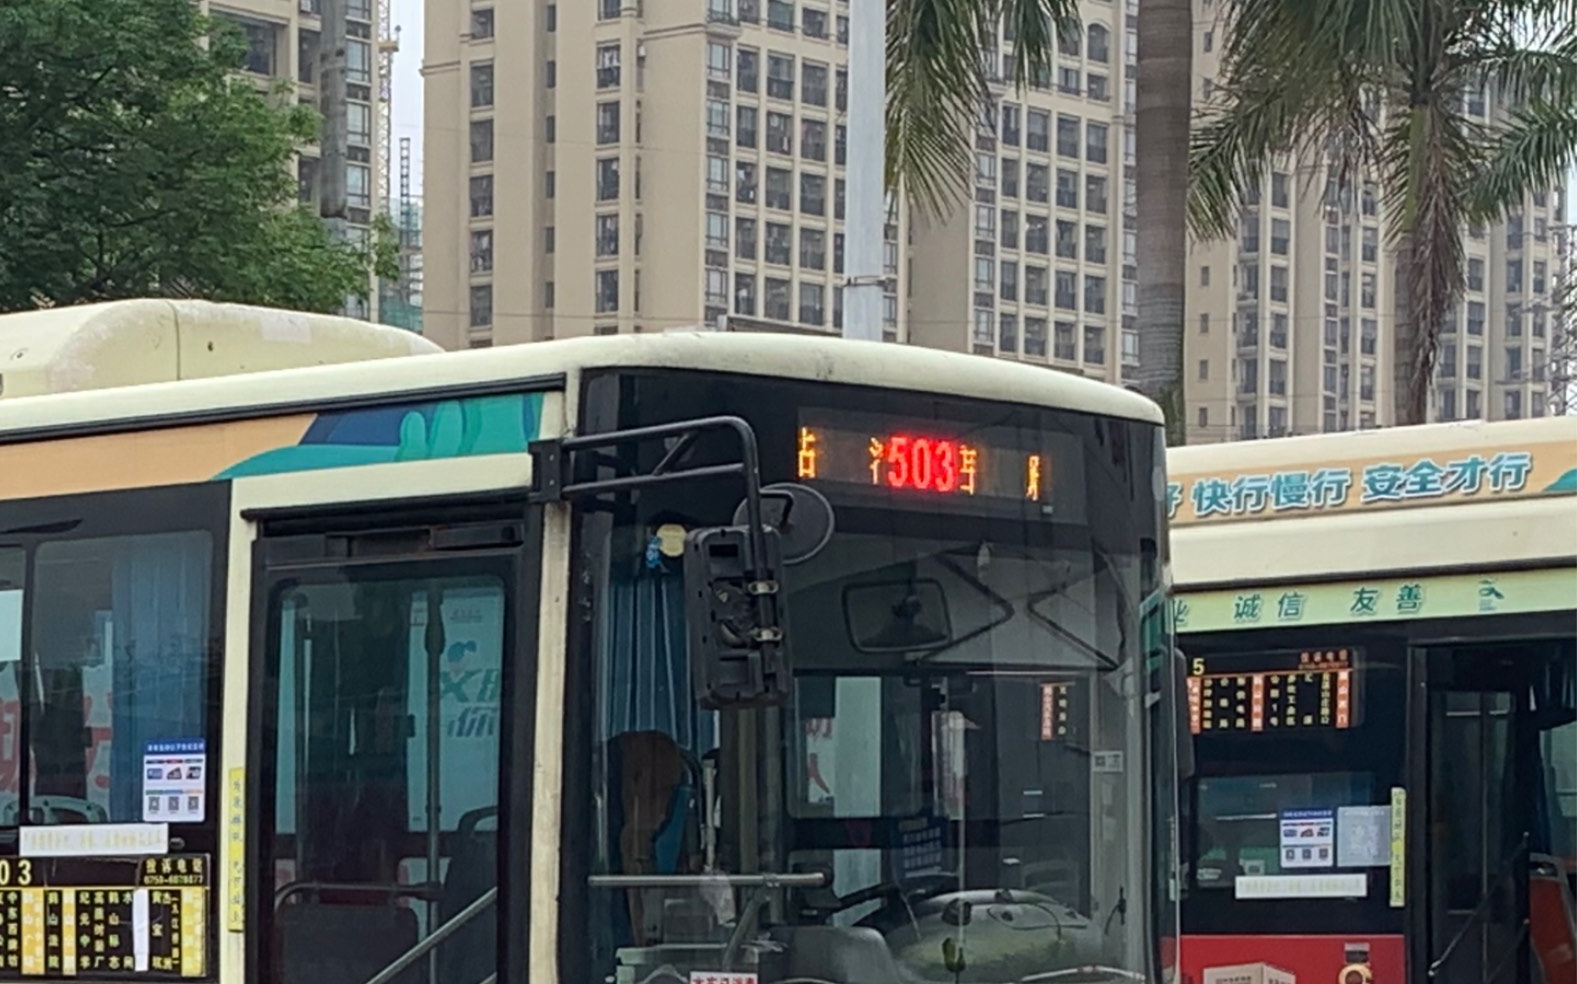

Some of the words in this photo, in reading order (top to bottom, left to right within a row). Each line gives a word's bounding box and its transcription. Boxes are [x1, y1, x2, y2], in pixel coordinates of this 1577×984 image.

[887, 436, 956, 492] 503
[1192, 470, 1350, 517] 快行慢行
[1361, 452, 1533, 502] 安全才行
[1233, 591, 1304, 623] 诚信
[1350, 583, 1426, 615] 友善
